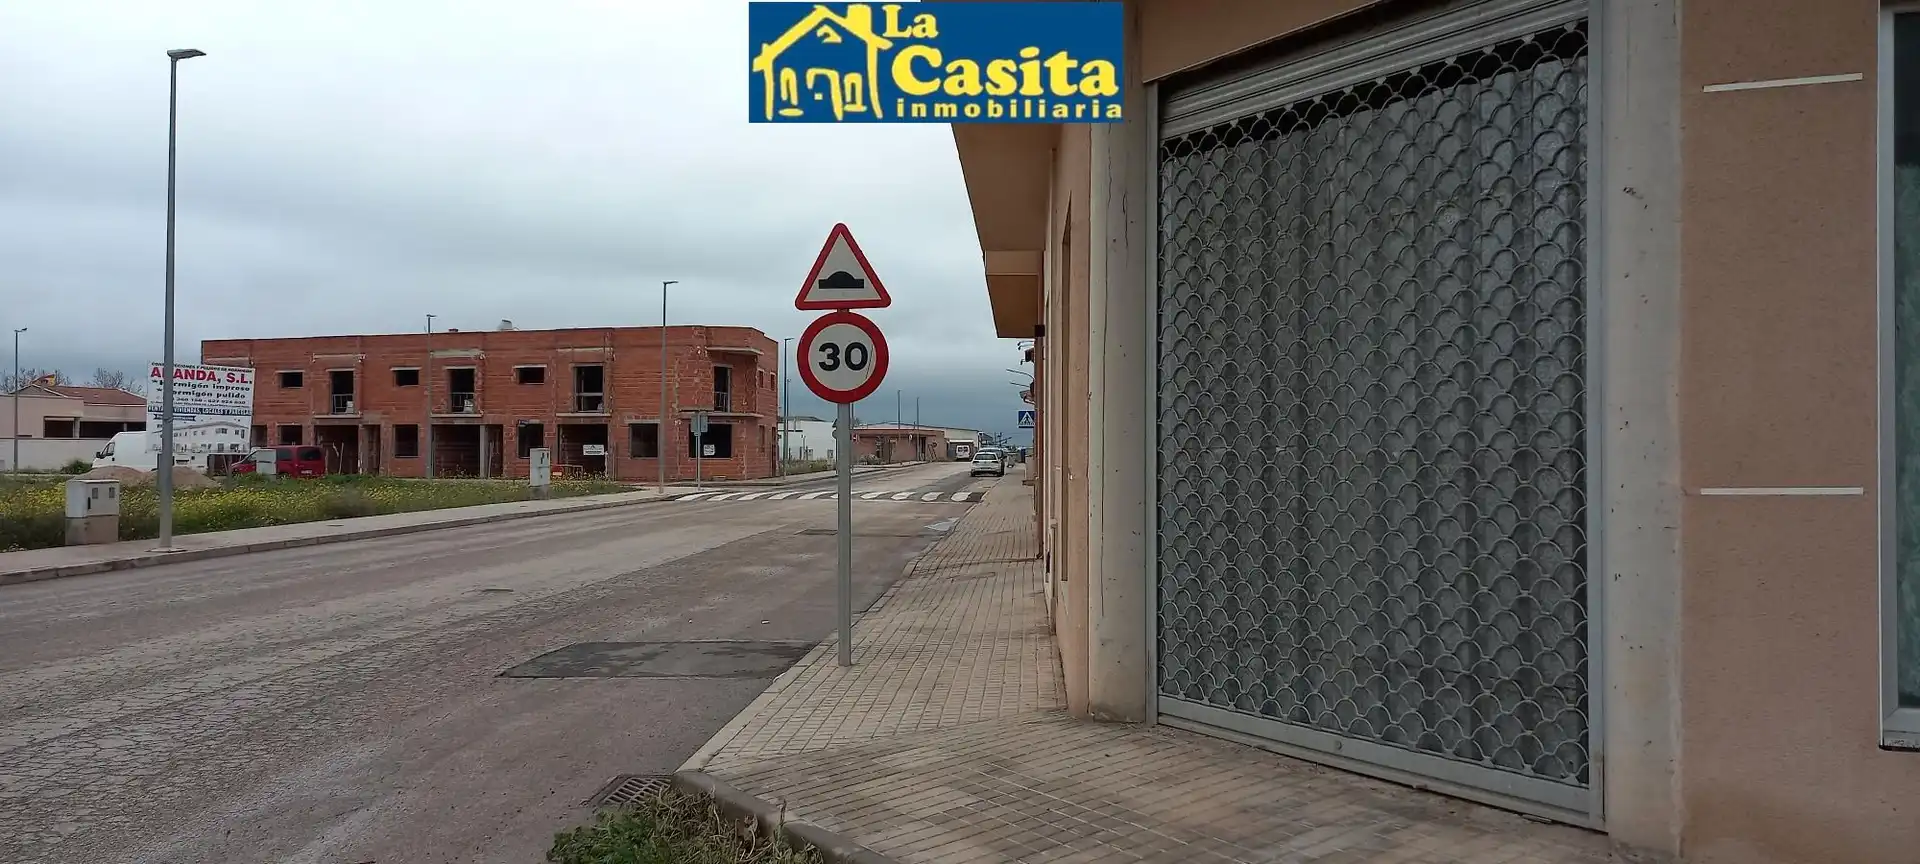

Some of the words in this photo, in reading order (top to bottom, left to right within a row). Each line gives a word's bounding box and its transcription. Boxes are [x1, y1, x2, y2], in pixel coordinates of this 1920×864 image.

[818, 341, 869, 372] 30
[151, 367, 221, 384] AANDA,
[226, 372, 253, 385] S.L.
[160, 380, 209, 390] Hrmigón
[212, 383, 250, 391] impreso
[169, 389, 213, 398] ormigón
[216, 391, 246, 399] pulido
